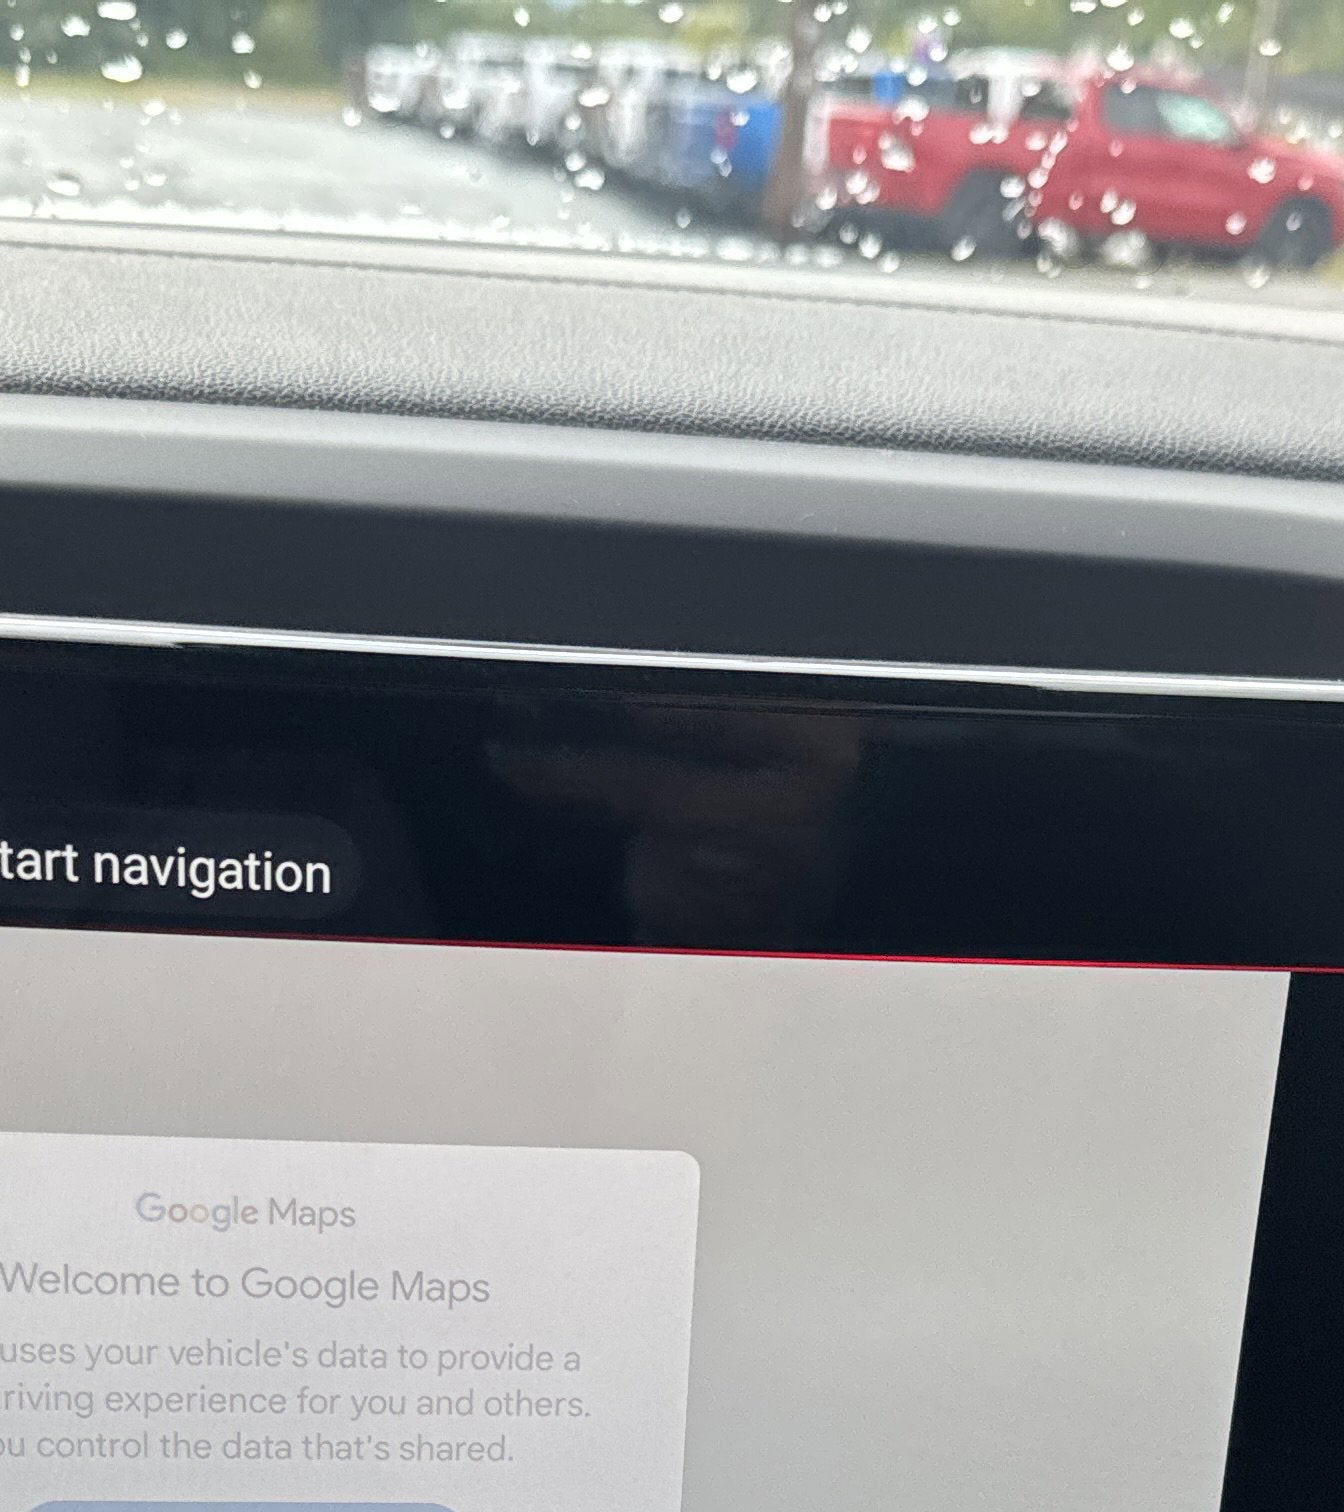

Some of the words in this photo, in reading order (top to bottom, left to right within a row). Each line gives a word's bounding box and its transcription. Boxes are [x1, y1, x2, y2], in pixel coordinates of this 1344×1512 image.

[95, 847, 330, 898] navigation
[135, 1192, 259, 1232] Google
[269, 1197, 356, 1234] Maps
[191, 1269, 229, 1297] to
[241, 1267, 379, 1309] Google
[392, 1270, 490, 1310] Maps
[0, 1343, 76, 1364] uses
[85, 1344, 158, 1371] your
[169, 1338, 308, 1368] vehicle's
[318, 1340, 387, 1369] data
[397, 1345, 428, 1369] to
[438, 1343, 553, 1376] provide
[564, 1352, 580, 1371] a
[105, 1385, 286, 1419] experience
[297, 1386, 341, 1414] for
[351, 1395, 406, 1421] you
[417, 1388, 474, 1416] and
[484, 1389, 590, 1417] others.
[37, 1431, 148, 1458] control
[160, 1431, 212, 1459] the
[222, 1431, 291, 1459] data
[302, 1433, 390, 1460] that's
[400, 1434, 513, 1462] shared.
